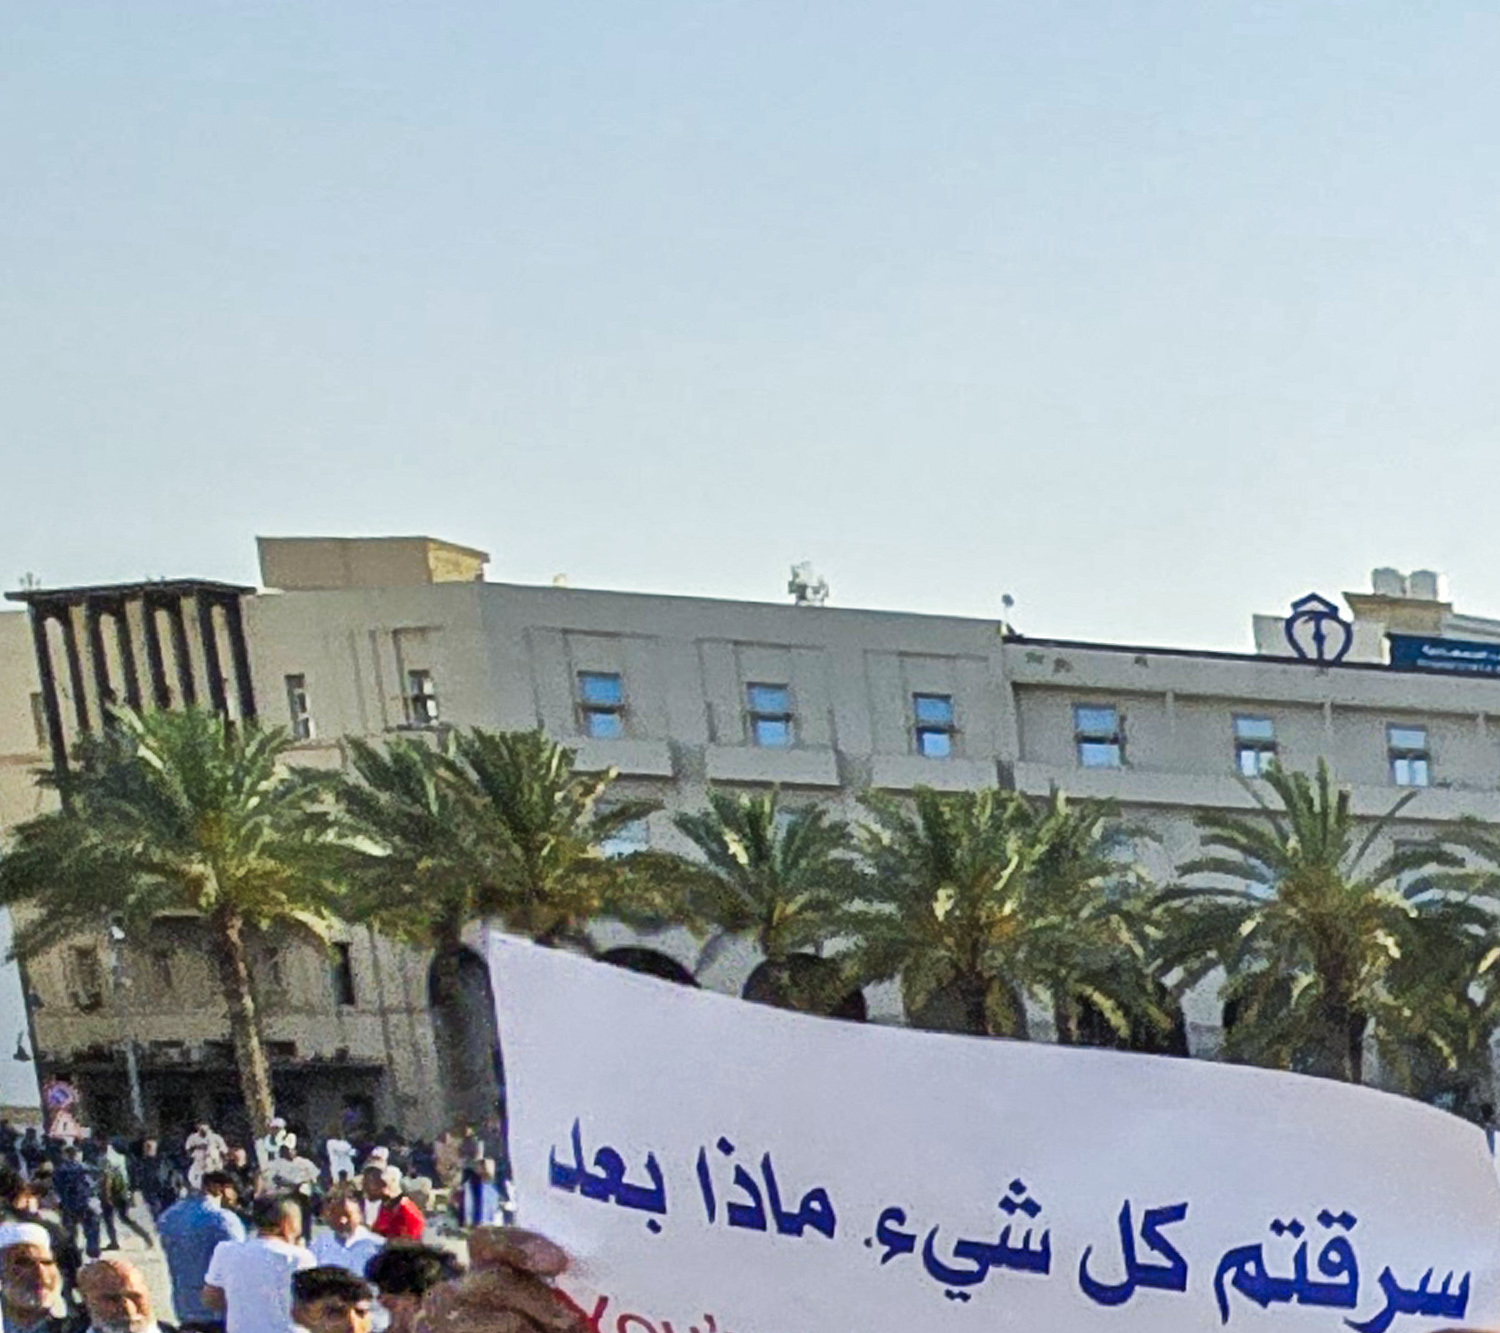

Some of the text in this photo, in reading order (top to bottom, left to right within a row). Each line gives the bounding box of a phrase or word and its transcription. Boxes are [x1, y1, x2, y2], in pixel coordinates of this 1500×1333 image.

[548, 1119, 667, 1236] بعد
[695, 1136, 837, 1239] ماذا
[874, 1177, 1051, 1302] شيء
[1077, 1201, 1190, 1306] كل
